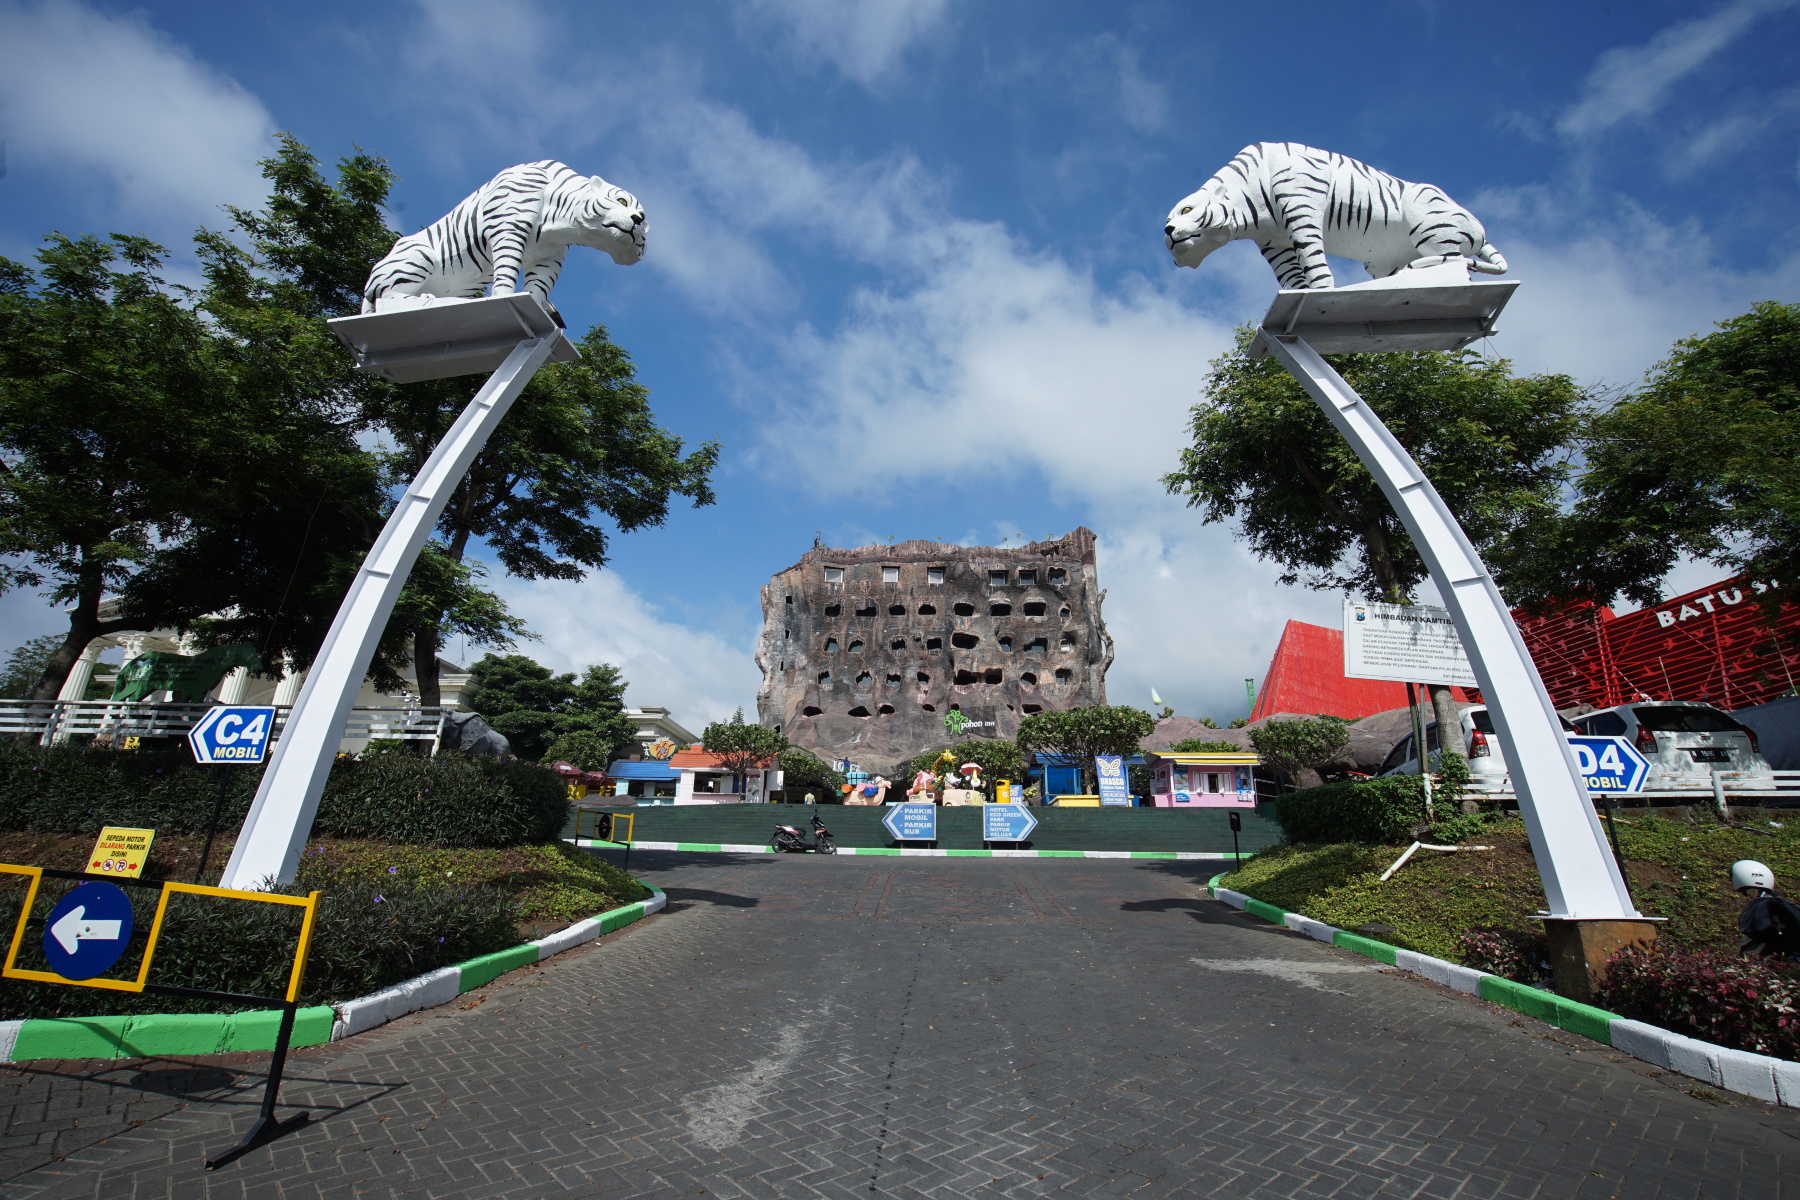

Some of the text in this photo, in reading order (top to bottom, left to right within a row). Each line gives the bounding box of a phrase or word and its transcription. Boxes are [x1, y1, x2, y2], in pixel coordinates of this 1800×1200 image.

[1656, 587, 1743, 628] BATU
[1374, 613, 1454, 625] HIMBAUAN KAMTIB
[215, 714, 266, 745] C4
[961, 720, 982, 730] pohon
[213, 747, 259, 758] MOBIL
[1569, 744, 1625, 775] D4
